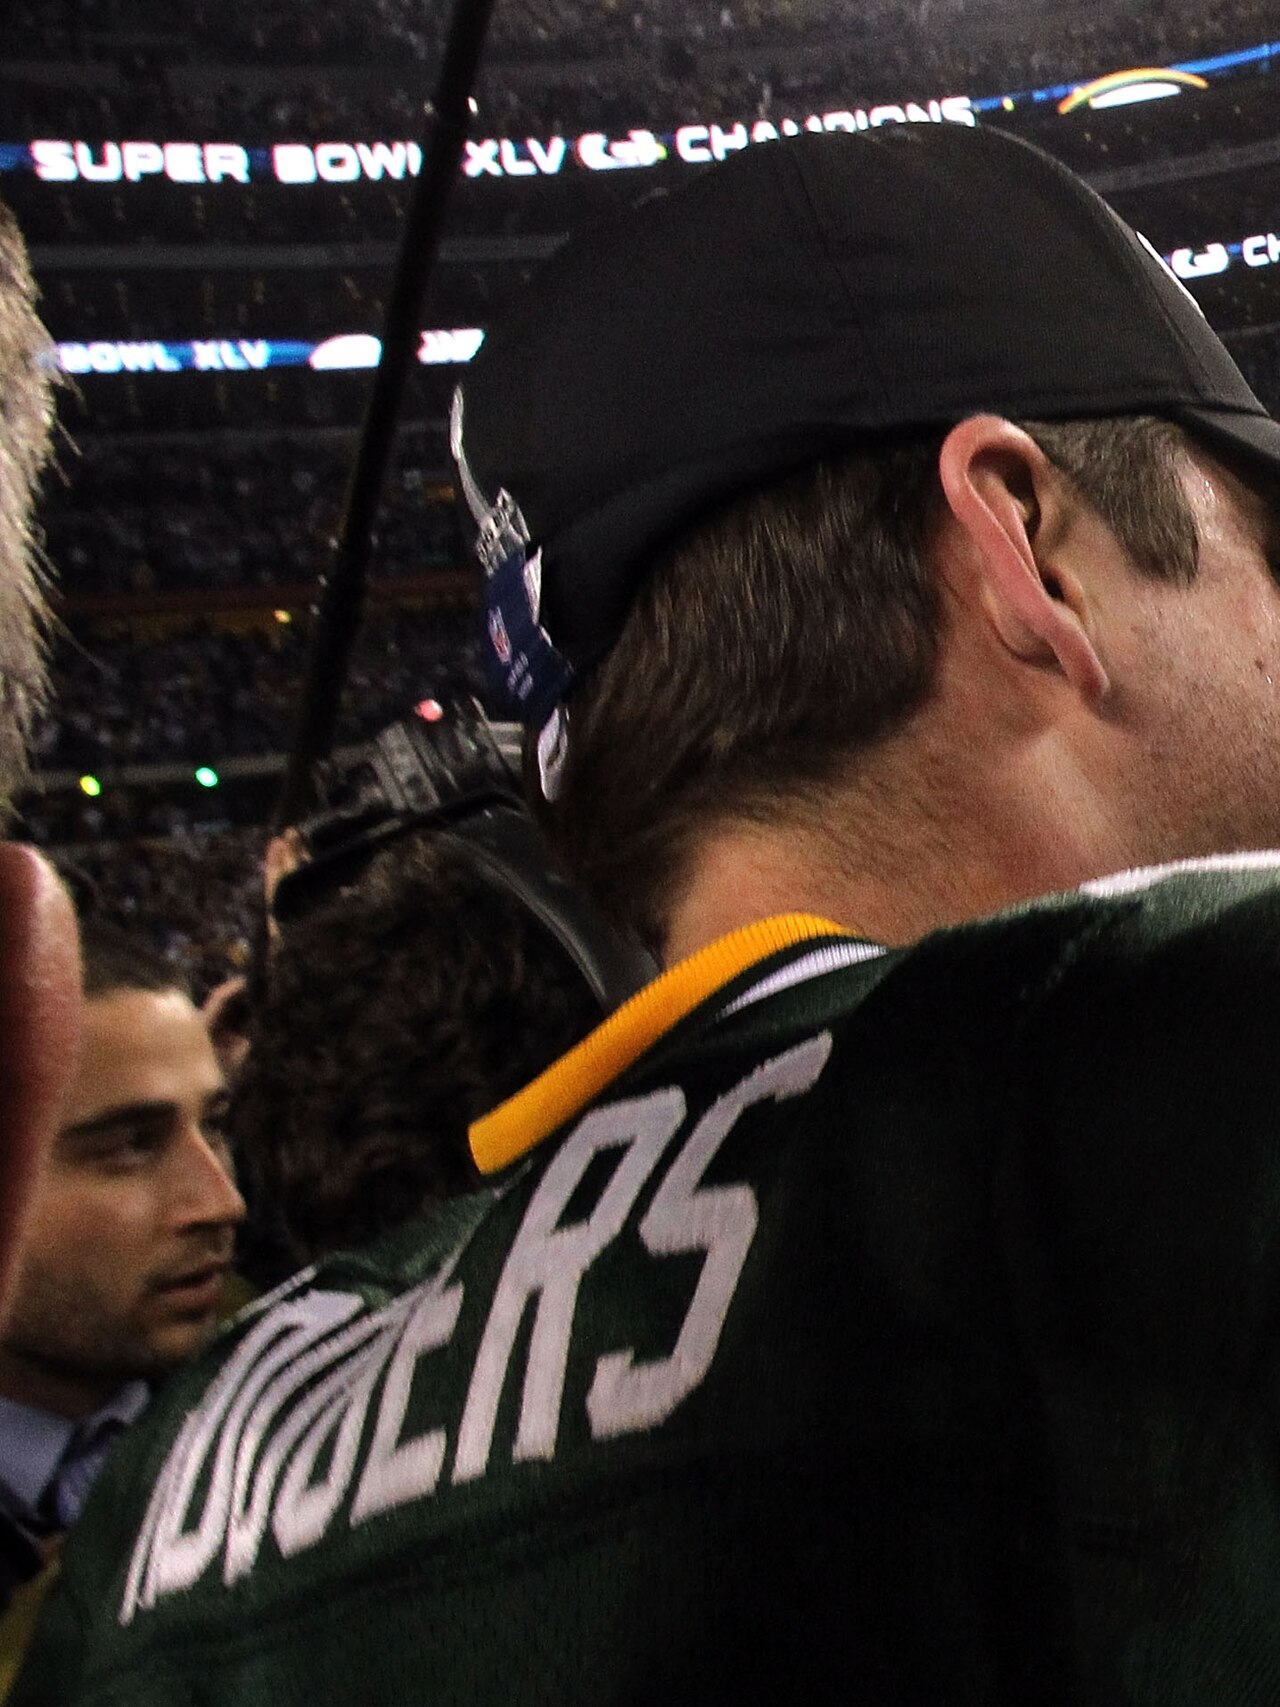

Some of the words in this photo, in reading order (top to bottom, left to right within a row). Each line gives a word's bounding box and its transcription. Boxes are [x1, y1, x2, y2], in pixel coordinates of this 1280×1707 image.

[30, 139, 250, 183] SUPER
[463, 136, 566, 176] XLV
[57, 341, 183, 374] BOWL
[191, 339, 270, 371] XLV
